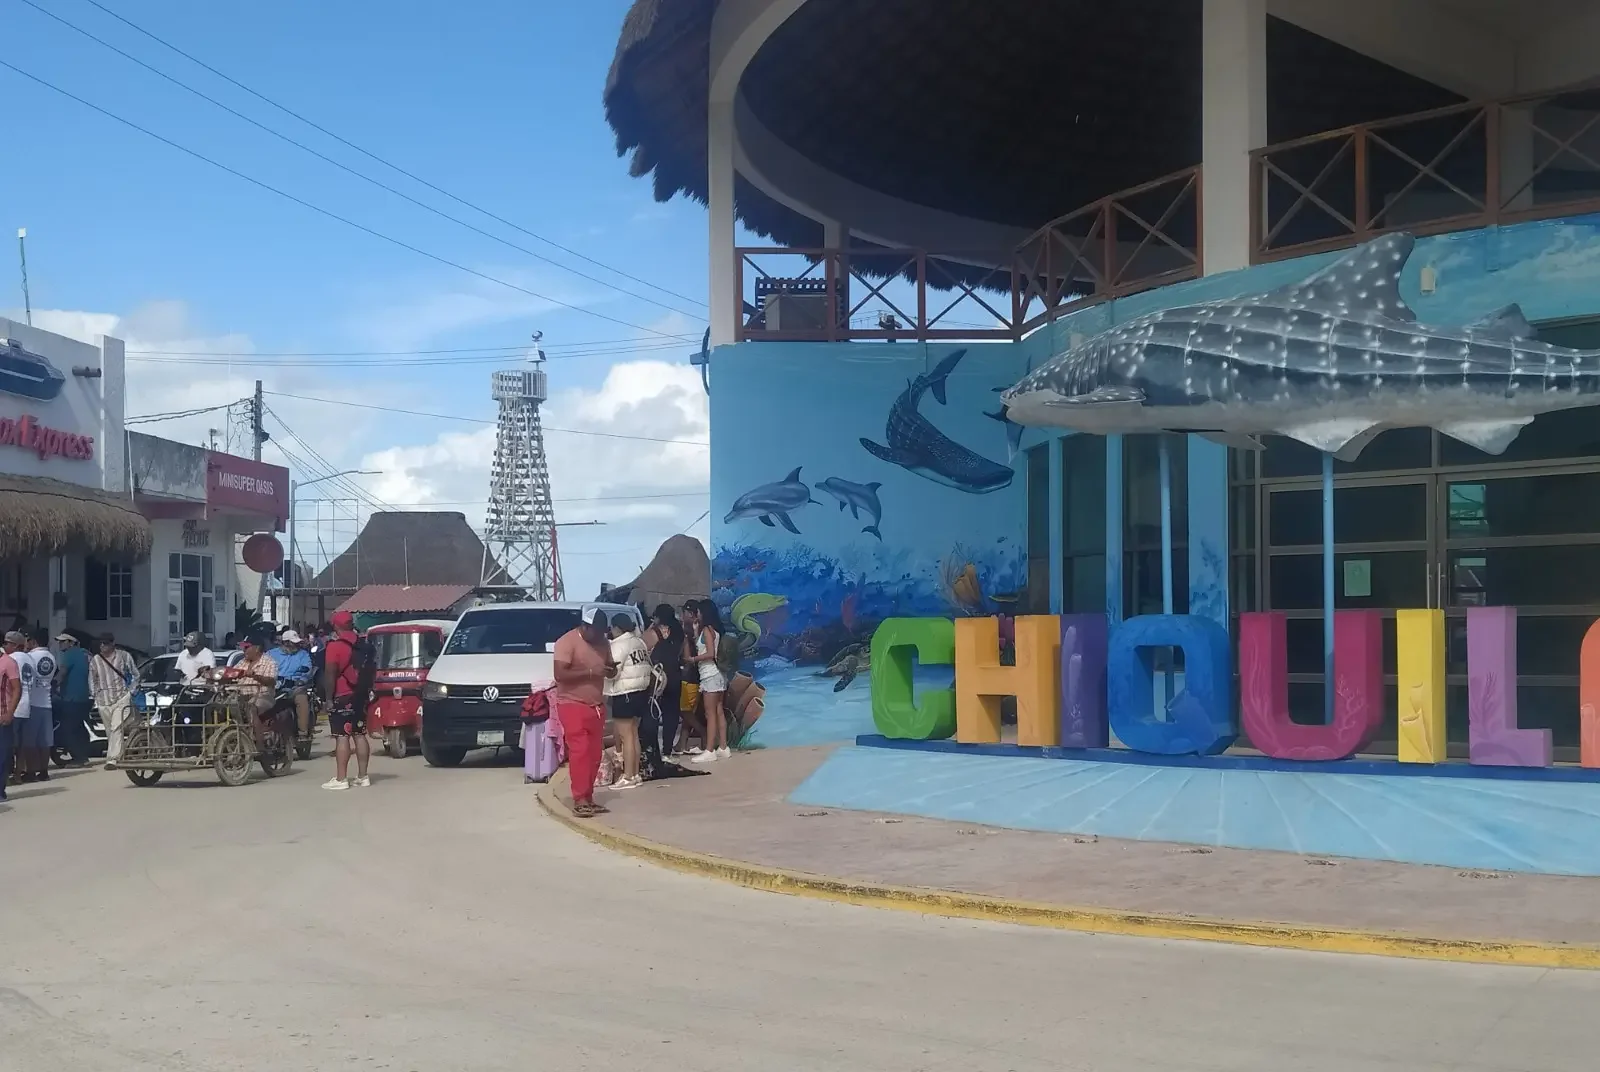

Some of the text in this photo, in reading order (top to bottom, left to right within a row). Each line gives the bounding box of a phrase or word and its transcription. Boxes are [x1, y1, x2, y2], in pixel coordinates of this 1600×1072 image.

[19, 413, 94, 460] Express
[219, 472, 274, 495] MINISUPER OASIS
[869, 606, 1600, 769] CHIQUIL
[374, 706, 381, 718] 4
[416, 705, 423, 717] 4
